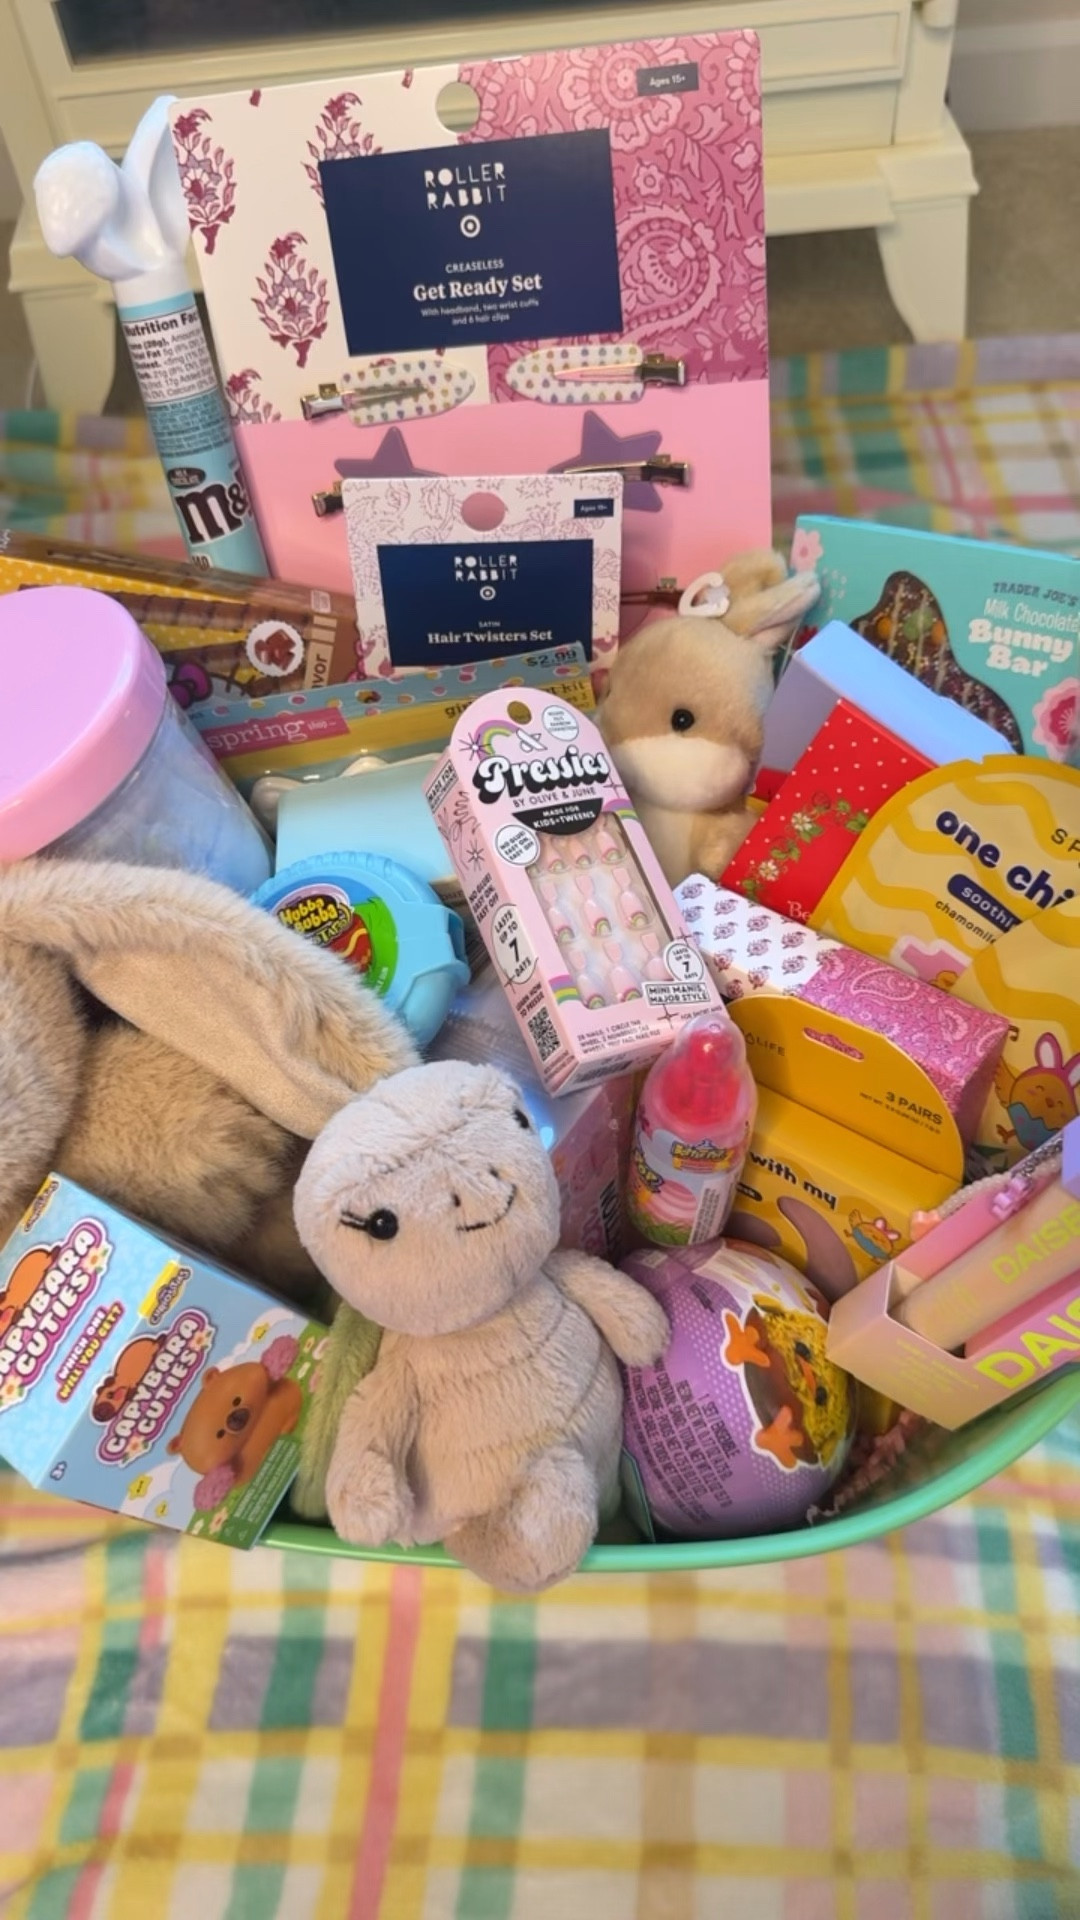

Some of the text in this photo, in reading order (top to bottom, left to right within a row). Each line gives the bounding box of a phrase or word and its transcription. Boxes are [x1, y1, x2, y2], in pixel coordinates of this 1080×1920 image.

[648, 73, 687, 88] Ages 15+
[424, 162, 506, 188] ROLLER
[427, 184, 507, 211] RABBIT
[445, 259, 504, 274] CREASELESS
[413, 272, 542, 302] Get Ready Set
[420, 297, 540, 318] With headband, two wrist cuffs
[452, 315, 468, 326] and
[476, 313, 491, 325] hair
[492, 311, 510, 326] clips
[454, 555, 518, 569] ROLLER
[455, 568, 518, 582] RABBIT
[993, 581, 1079, 608] TRADER JOE'S
[983, 598, 1080, 634] Milk Chocolate
[428, 629, 553, 644] Hair Twisters Set
[968, 617, 1075, 664] Bunny
[312, 654, 328, 688] vor
[526, 651, 577, 668] $2.99
[986, 644, 1049, 678] Bar
[206, 718, 310, 753] spring
[475, 744, 610, 802] Pressies
[512, 786, 597, 808] BY OLIVE & JUNE
[542, 805, 580, 817] MADE FOR
[500, 840, 510, 852] NO
[504, 844, 519, 856] EASY
[509, 840, 535, 862] EASY OFF
[936, 811, 1001, 869] one
[469, 889, 479, 901] NO
[488, 893, 499, 909] OFF
[279, 897, 325, 928] Hubba
[294, 903, 338, 933] Bubba
[495, 910, 513, 933] LASTS
[787, 900, 811, 920] Be
[501, 923, 518, 944] UP TO
[509, 937, 520, 962] 7
[515, 958, 532, 977] DAYS
[682, 961, 690, 973] 7
[886, 1091, 896, 1103] 3
[899, 1096, 944, 1126] PAIRS
[749, 1152, 837, 1211] with my
[991, 1202, 1080, 1286] DAISE
[0, 1229, 96, 1375] APYBARA
[15, 1268, 90, 1376] CUTIES
[58, 1308, 107, 1379] WHICH ONE
[60, 1367, 83, 1398] WILL
[79, 1338, 100, 1365] YOU
[106, 1316, 199, 1453] CAPYBARA
[137, 1348, 199, 1434] CUTIES
[50, 1461, 68, 1481] 3+
